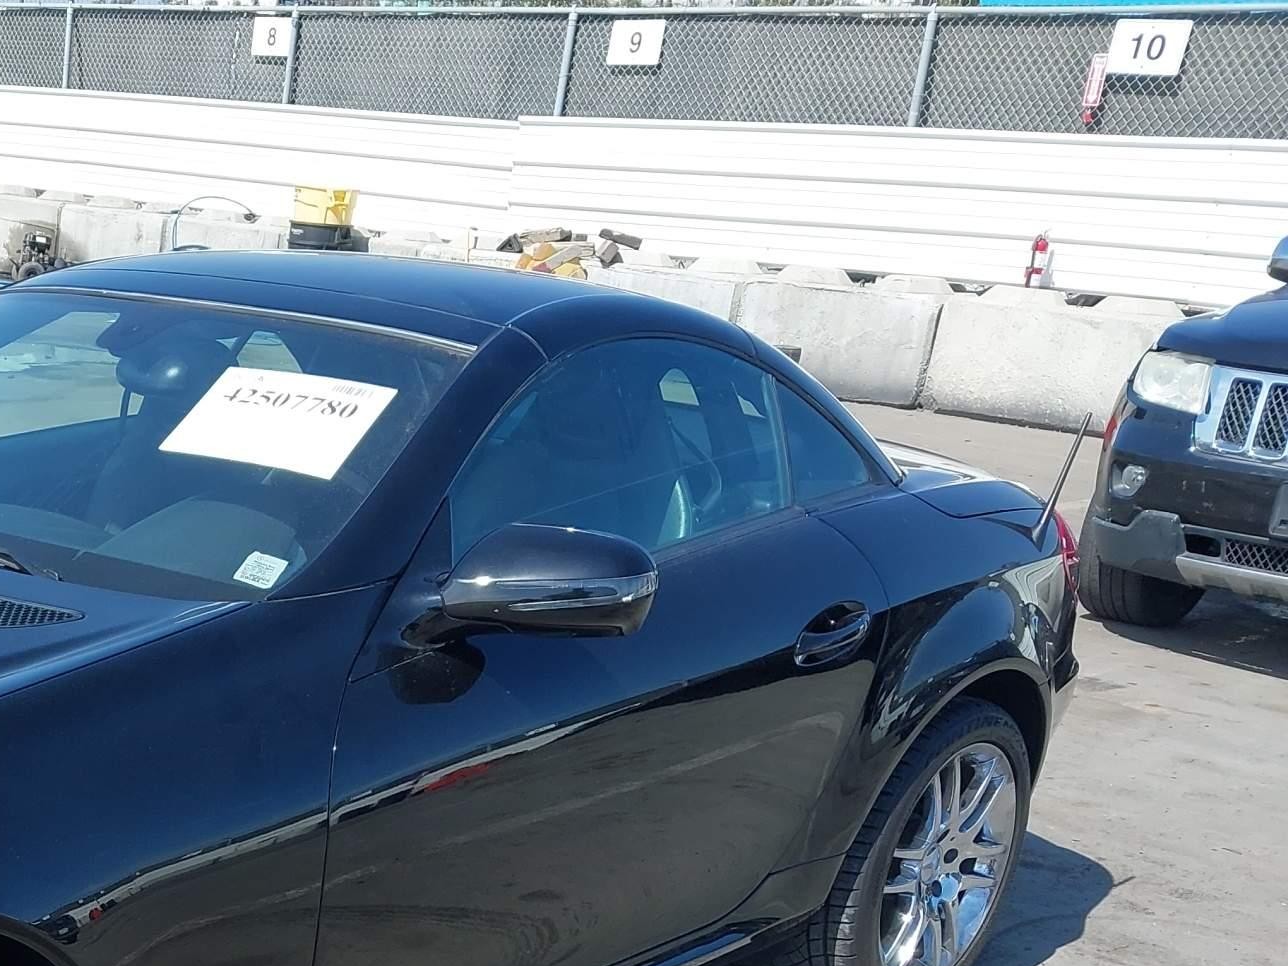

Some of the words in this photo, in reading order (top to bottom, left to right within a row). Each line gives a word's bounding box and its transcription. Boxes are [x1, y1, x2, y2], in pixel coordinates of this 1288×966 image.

[267, 27, 276, 46] 8
[629, 32, 642, 53] 9
[1132, 34, 1166, 60] 10
[224, 387, 359, 419] 42507780
